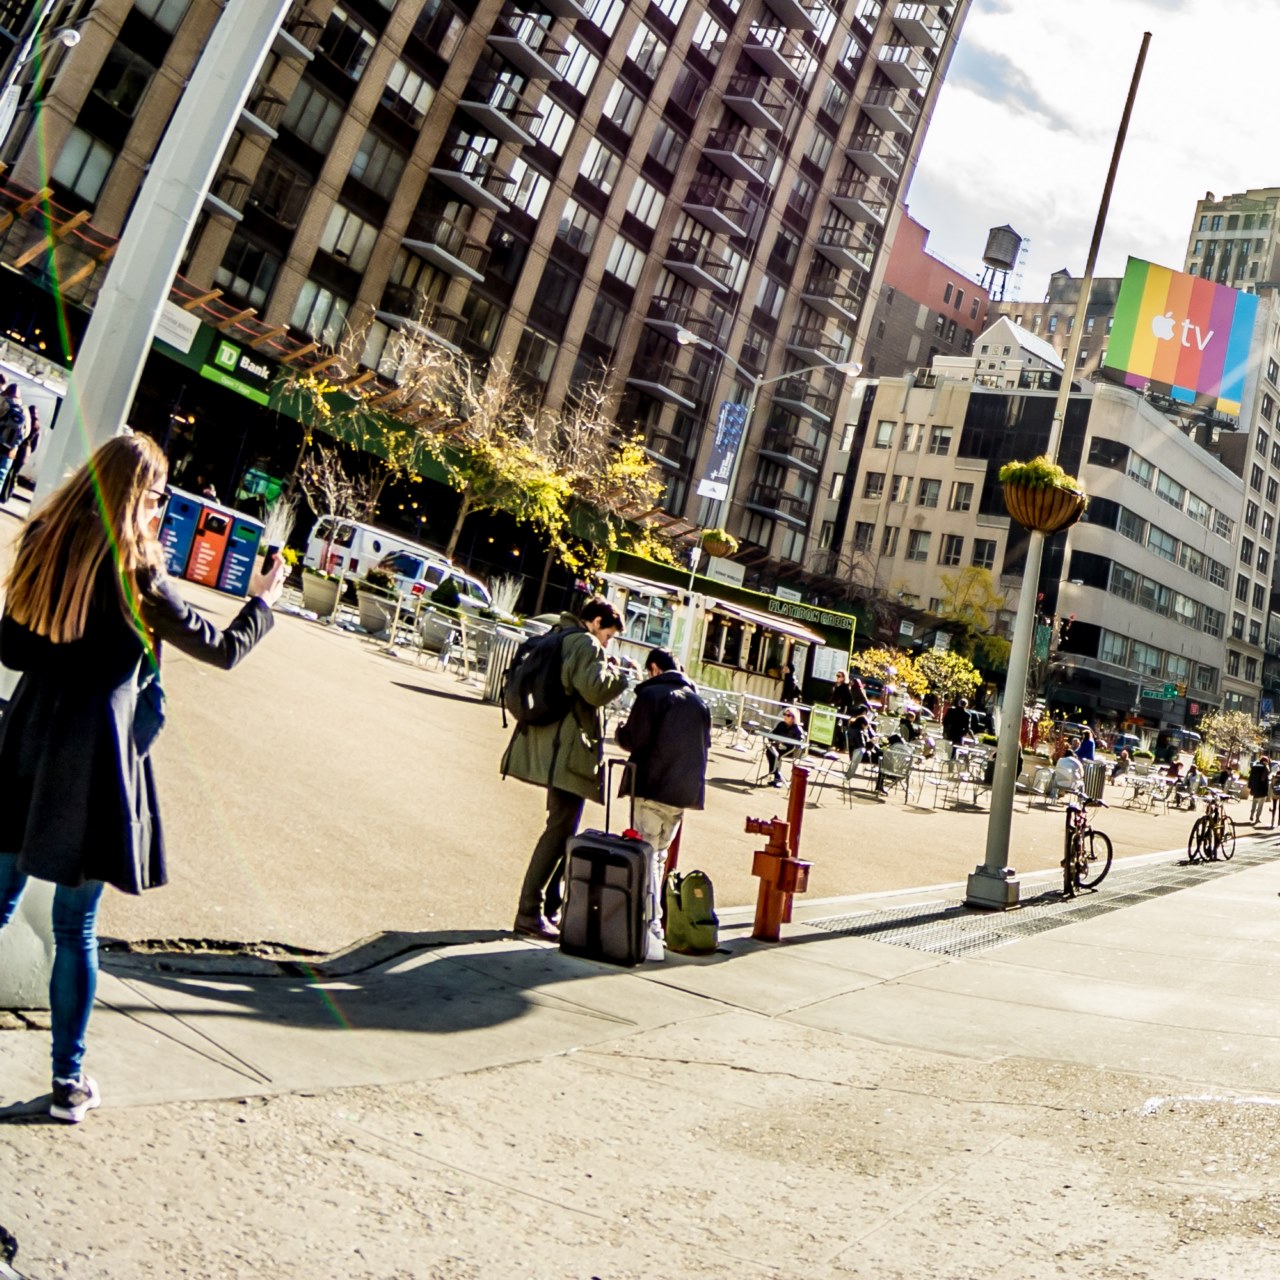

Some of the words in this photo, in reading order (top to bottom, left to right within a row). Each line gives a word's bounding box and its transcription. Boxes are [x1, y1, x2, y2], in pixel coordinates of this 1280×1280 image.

[1181, 319, 1214, 351] tv
[221, 345, 237, 366] TD
[240, 355, 270, 380] Bank
[769, 600, 820, 623] FLATIRON
[820, 611, 853, 630] GREEN
